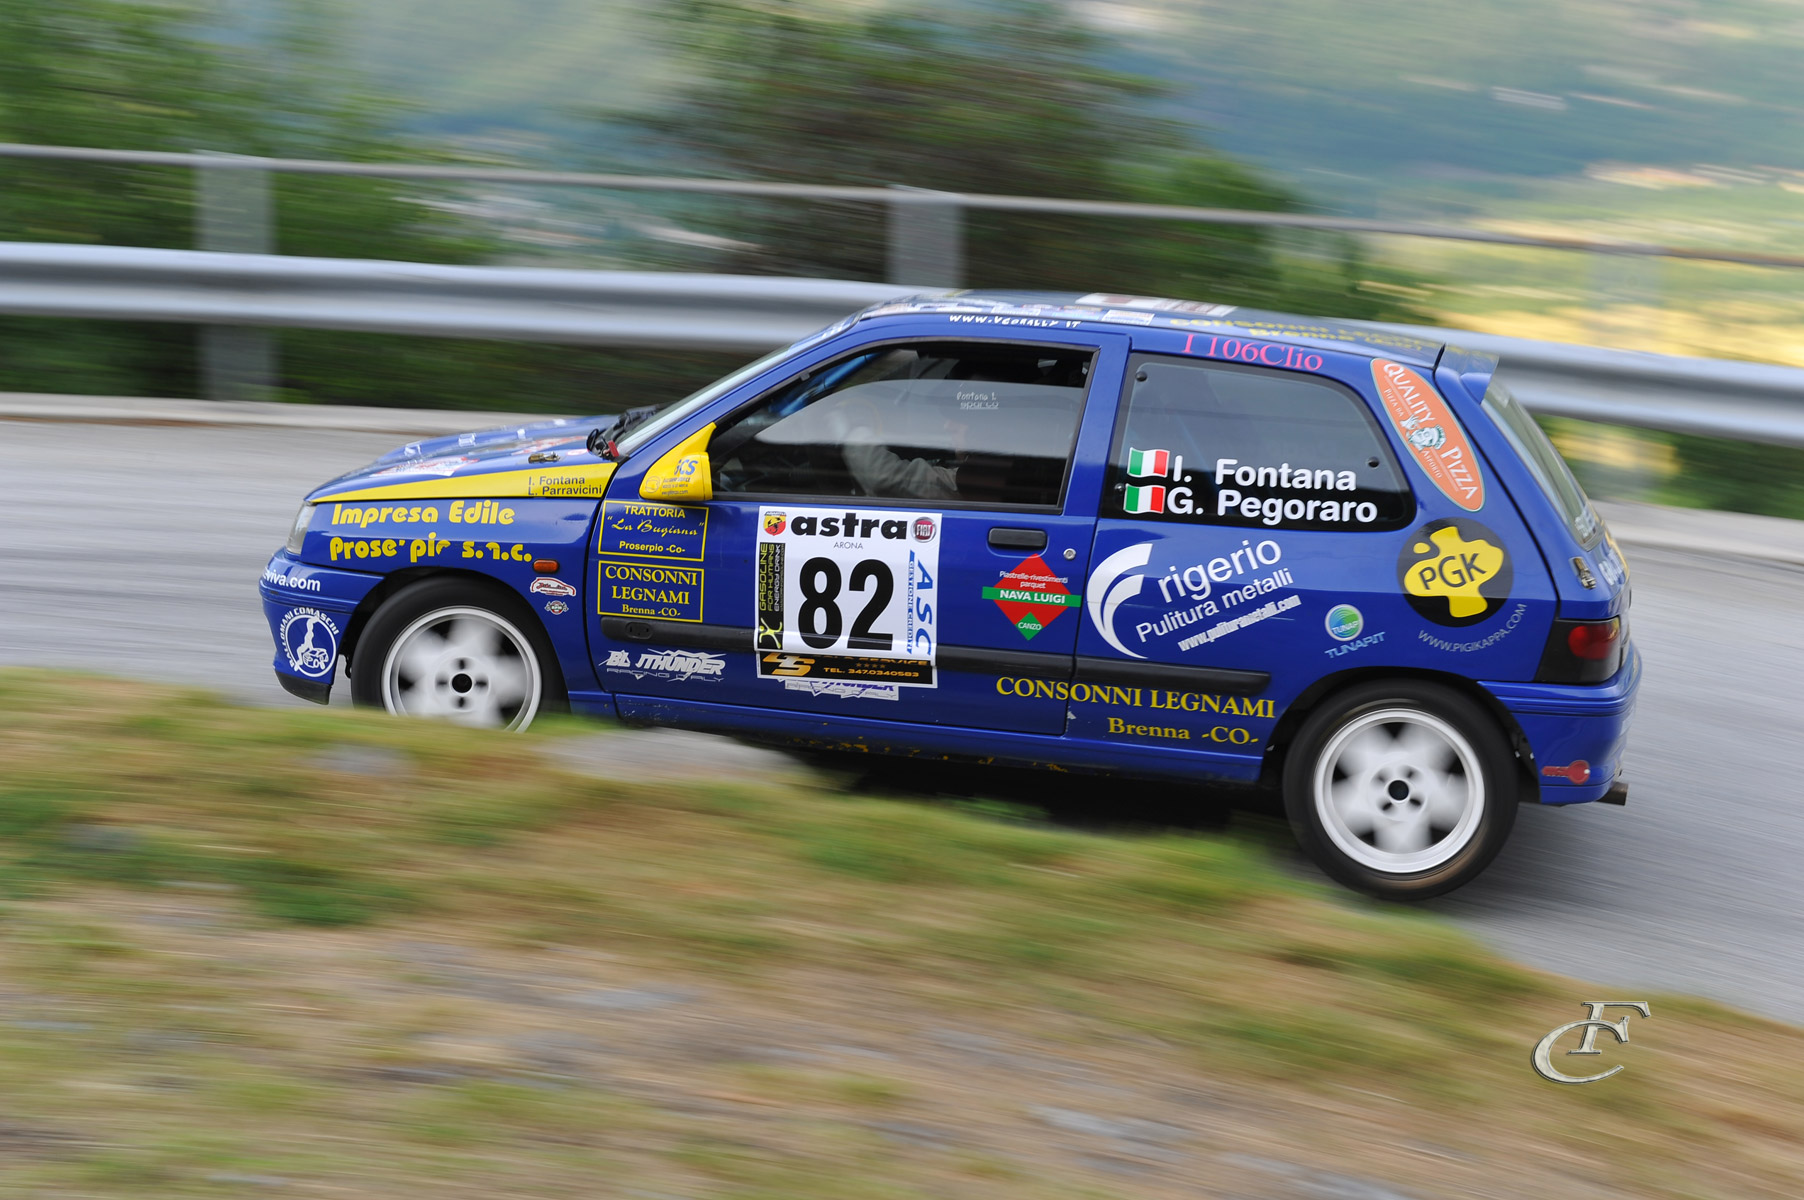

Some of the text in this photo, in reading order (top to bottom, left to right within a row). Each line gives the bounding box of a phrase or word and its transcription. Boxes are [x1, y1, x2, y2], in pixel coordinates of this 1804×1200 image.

[1207, 336, 1324, 371] 106Clio
[1383, 363, 1436, 423] QUALITY
[539, 475, 585, 486] Fontana
[1172, 455, 1357, 491] I. Fontana
[1440, 445, 1479, 500] PIZZA
[542, 485, 602, 496] Parravicini
[331, 499, 516, 528] Impresa Edile
[624, 505, 686, 518] TRATTORIA
[1166, 486, 1378, 526] G. Pegoraro
[790, 512, 908, 540] astra
[619, 540, 664, 553] Proserpio
[833, 541, 864, 550] ARONA
[605, 565, 698, 586] CONSONNI
[759, 543, 768, 611] GASOLINE
[1020, 581, 1046, 589] parquet
[1417, 552, 1487, 591] PGK
[611, 585, 690, 605] LEGNAMI
[622, 603, 656, 615] Brenna
[797, 556, 895, 651] 82
[915, 559, 934, 656] ASC
[1000, 590, 1066, 604] NAVA LUIGI
[1135, 567, 1294, 643] Pulitura metalli
[1017, 622, 1043, 631] CANZO
[995, 676, 1276, 719] CONSONNI LEGNAMI
[1107, 717, 1191, 740] Brenna
